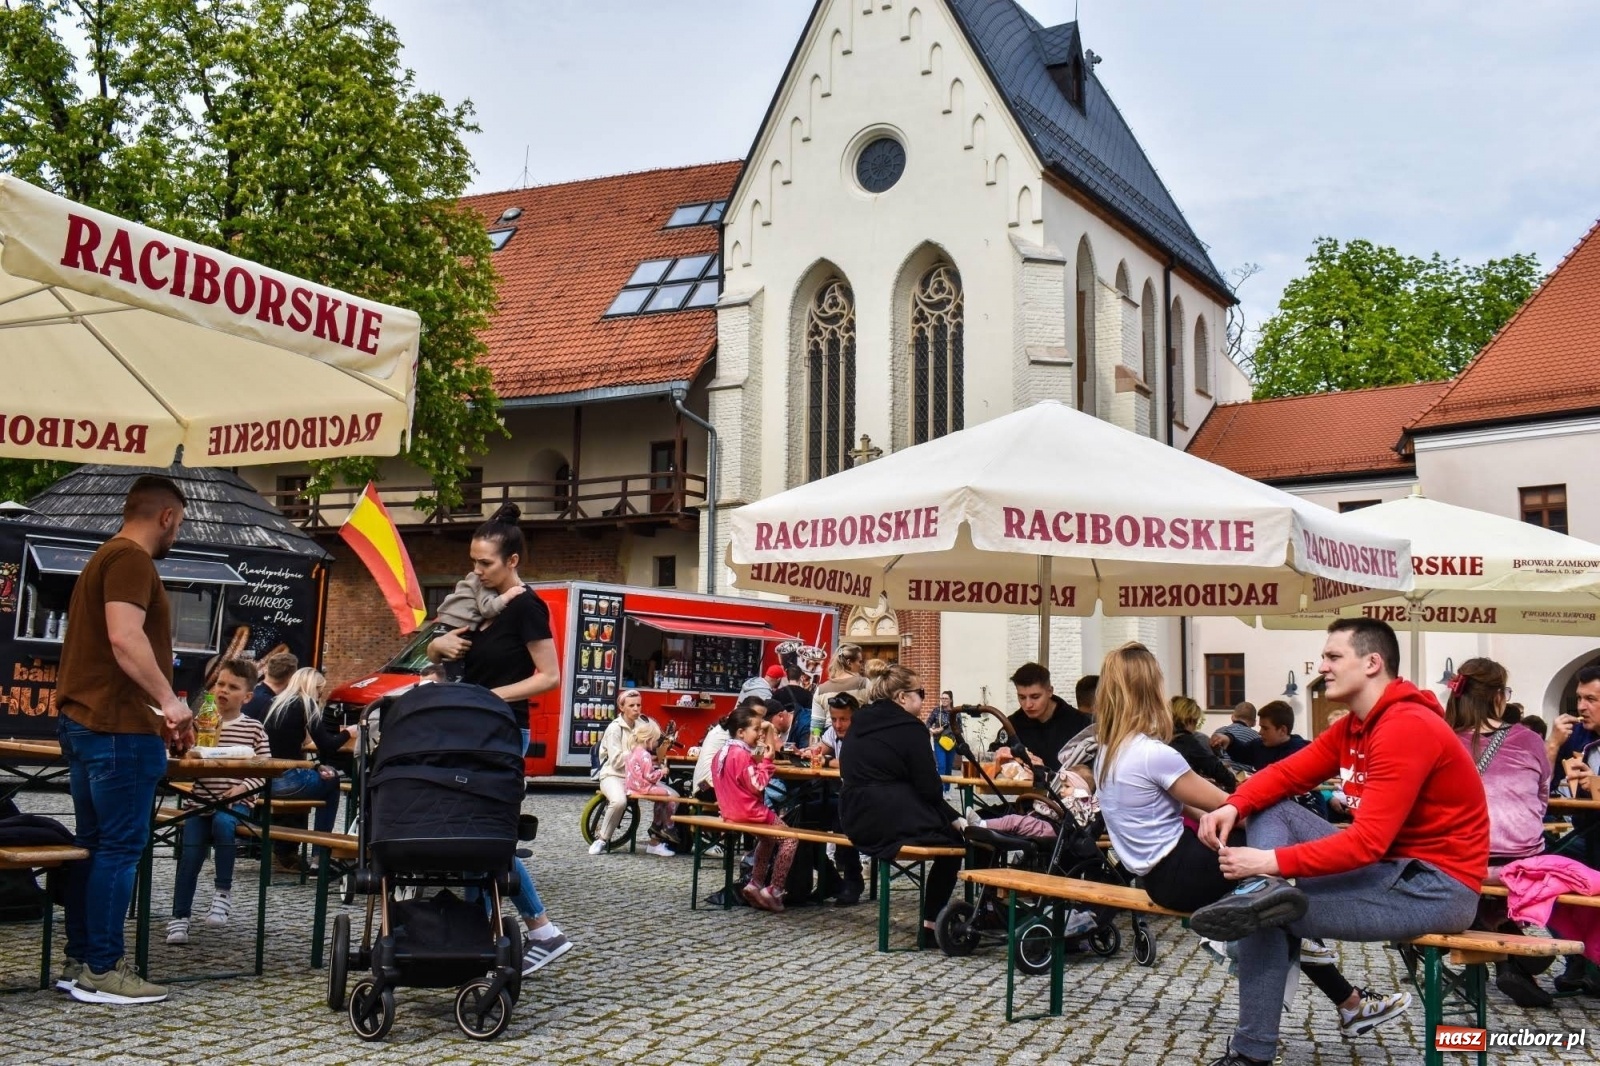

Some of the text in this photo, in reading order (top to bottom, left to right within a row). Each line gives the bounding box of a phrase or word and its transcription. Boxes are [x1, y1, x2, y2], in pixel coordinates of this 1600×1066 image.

[60, 213, 383, 355] RACIBORSKIE
[755, 506, 939, 551] RACIBORSKIE
[1002, 506, 1255, 552] RACIBORSKIE
[1303, 529, 1398, 579] RACIBORSKIE
[238, 561, 304, 579] Prawdopodobnie
[1513, 559, 1600, 569] BROWAR ZAMKOW
[247, 579, 290, 596] najlepsze
[239, 594, 294, 610] CHURROS
[273, 610, 303, 626] Polsce
